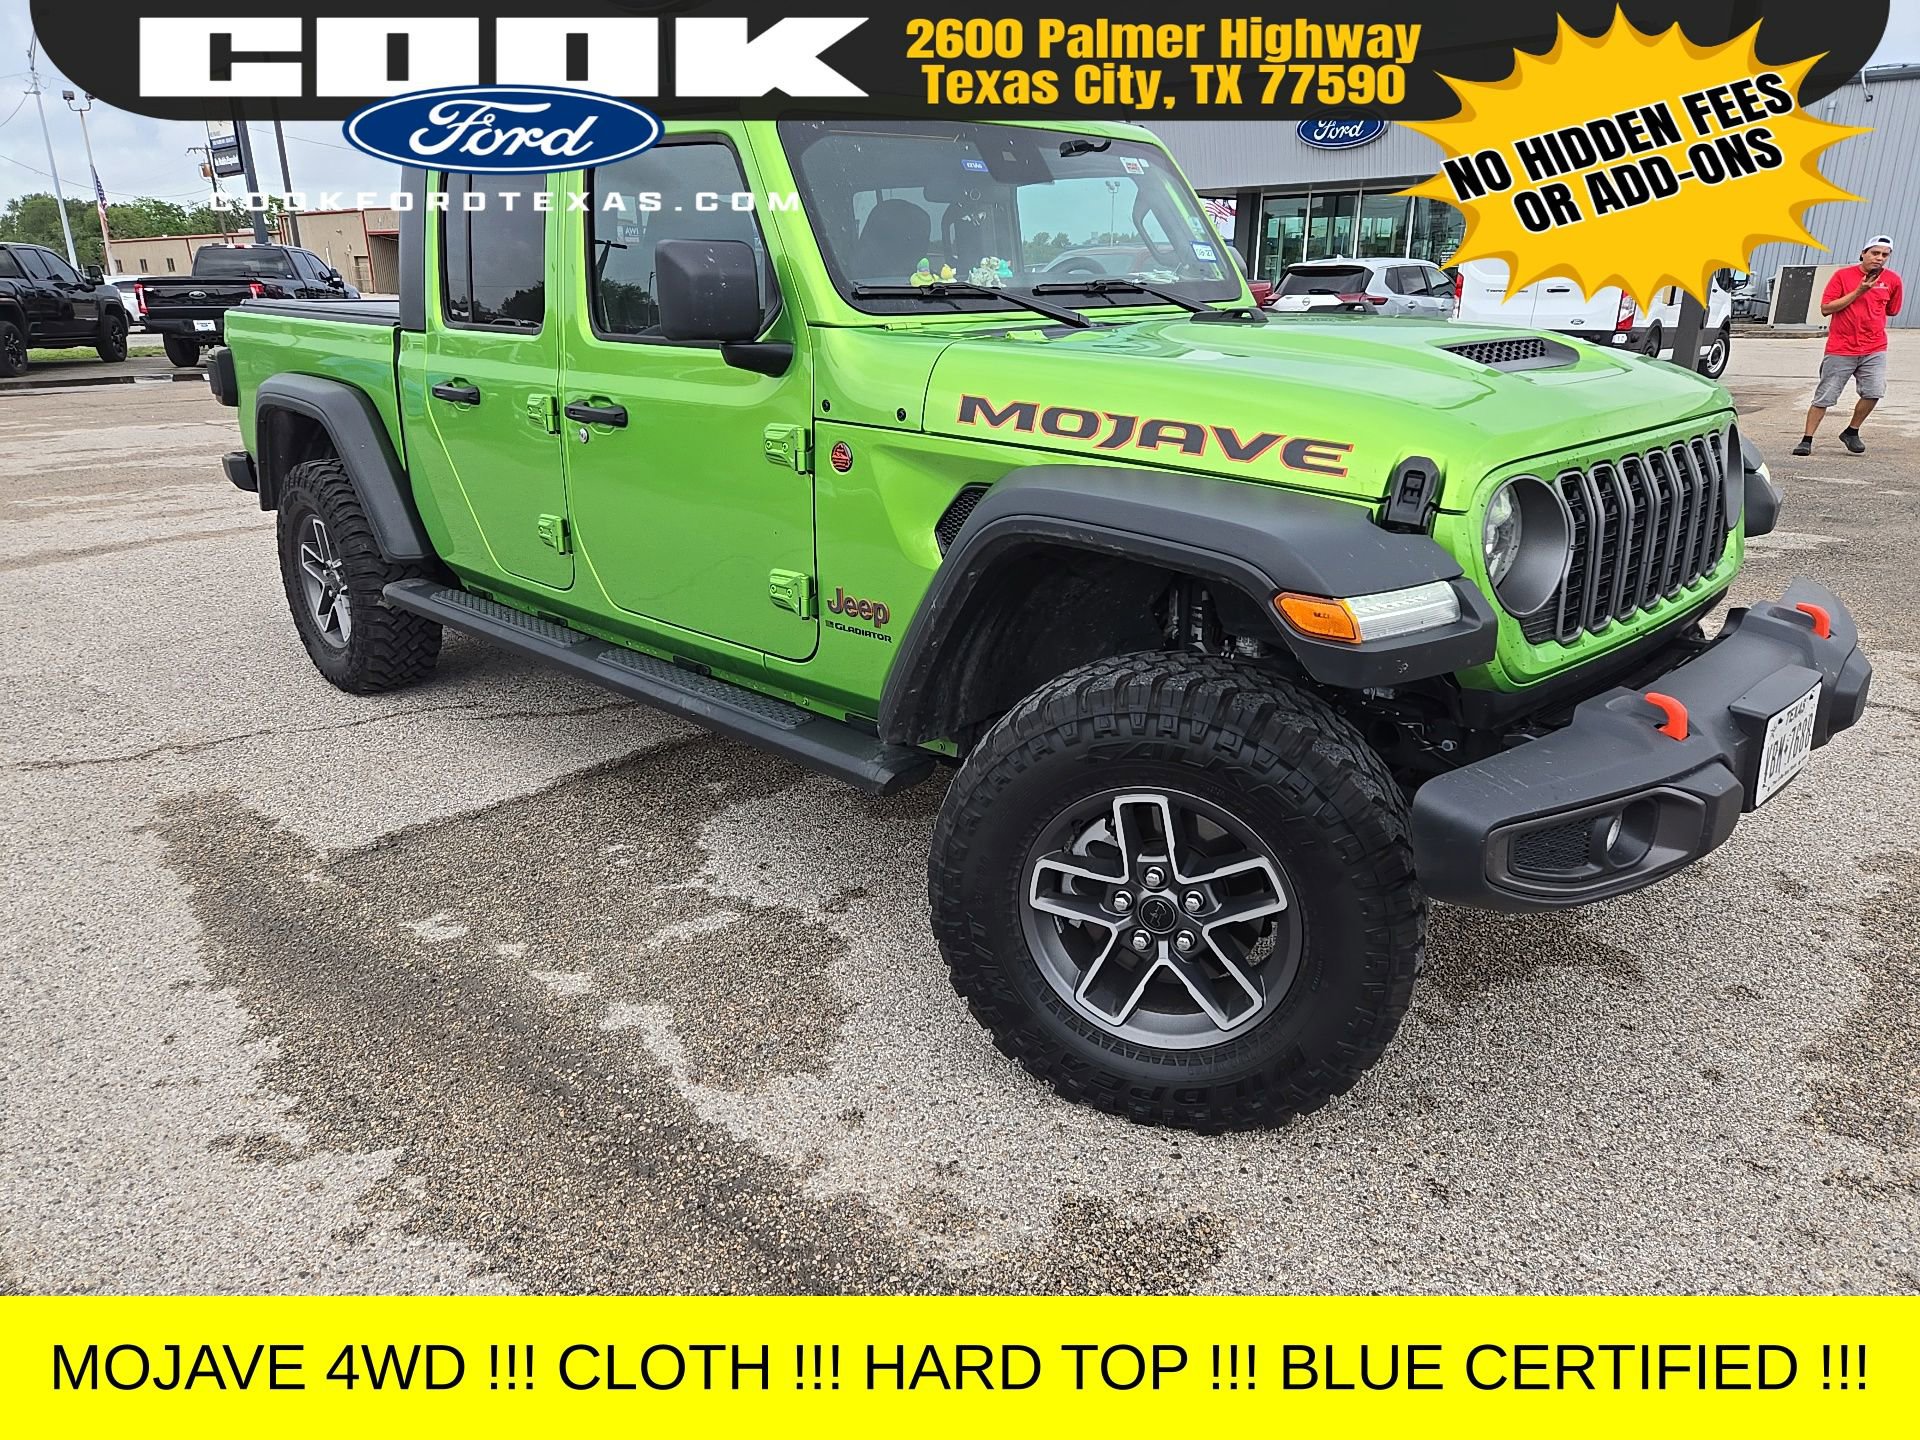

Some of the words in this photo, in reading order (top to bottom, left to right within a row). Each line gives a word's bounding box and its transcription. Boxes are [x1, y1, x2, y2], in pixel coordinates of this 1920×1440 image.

[1314, 118, 1364, 140] Ford
[956, 393, 1354, 477] MOJAVE
[826, 586, 890, 629] Jeep
[834, 622, 893, 643] GLADIATOR
